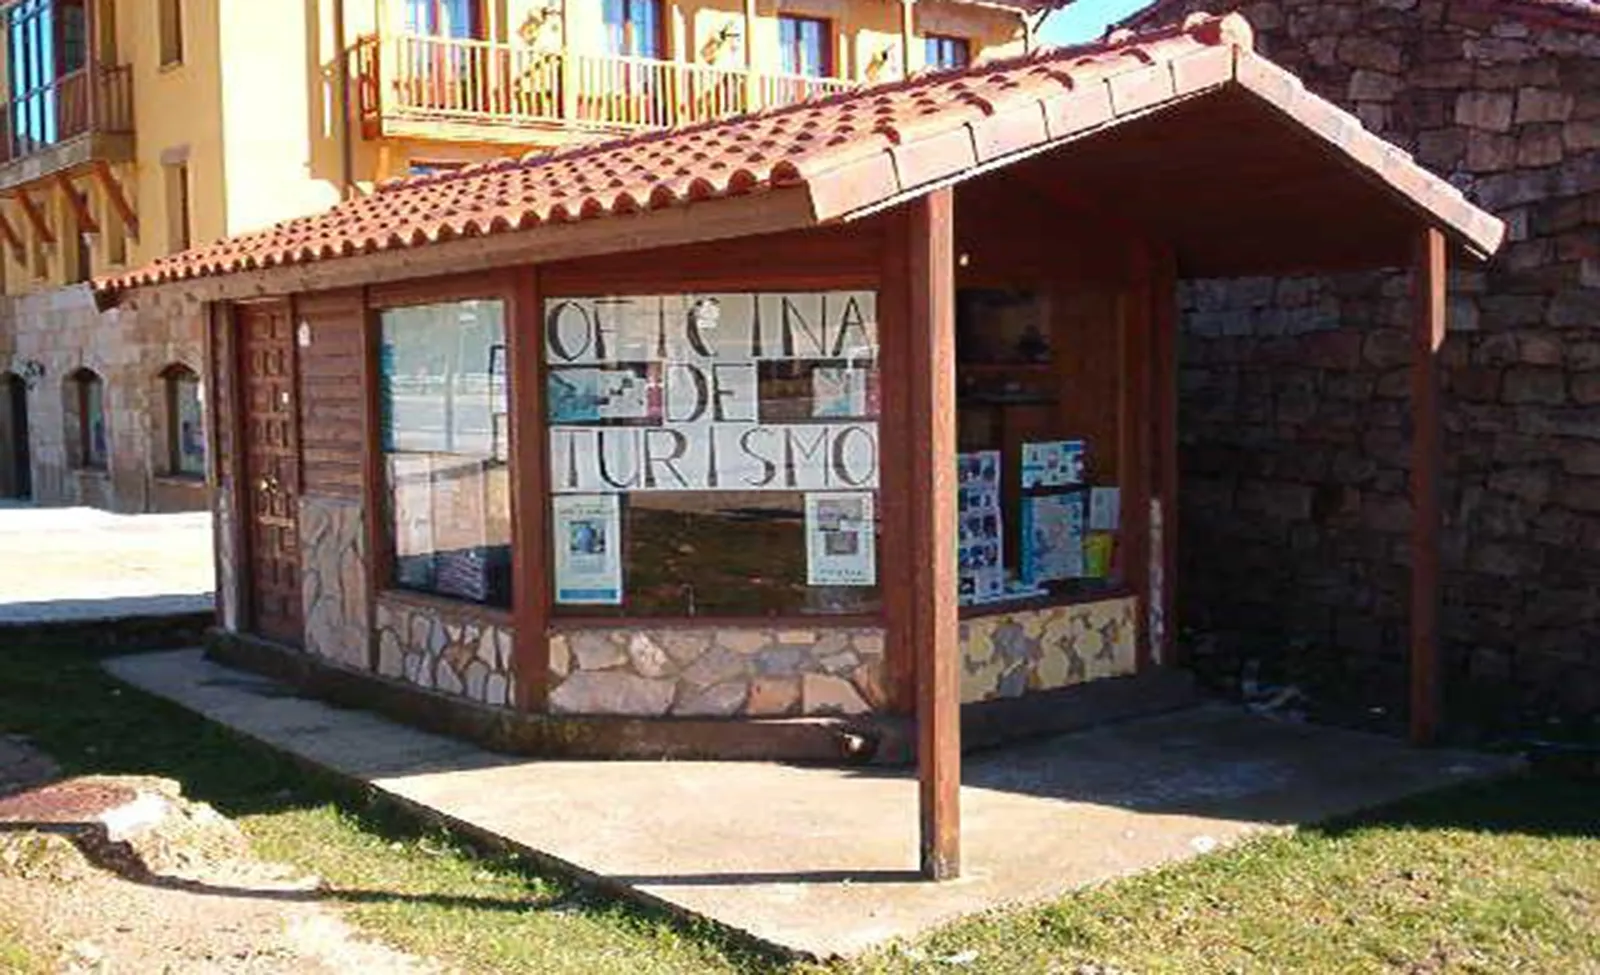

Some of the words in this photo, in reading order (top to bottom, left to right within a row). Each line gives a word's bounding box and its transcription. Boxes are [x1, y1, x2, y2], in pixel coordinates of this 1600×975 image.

[547, 295, 872, 362] OFICINA
[665, 363, 756, 422] DE
[553, 426, 877, 490] TURISMO
